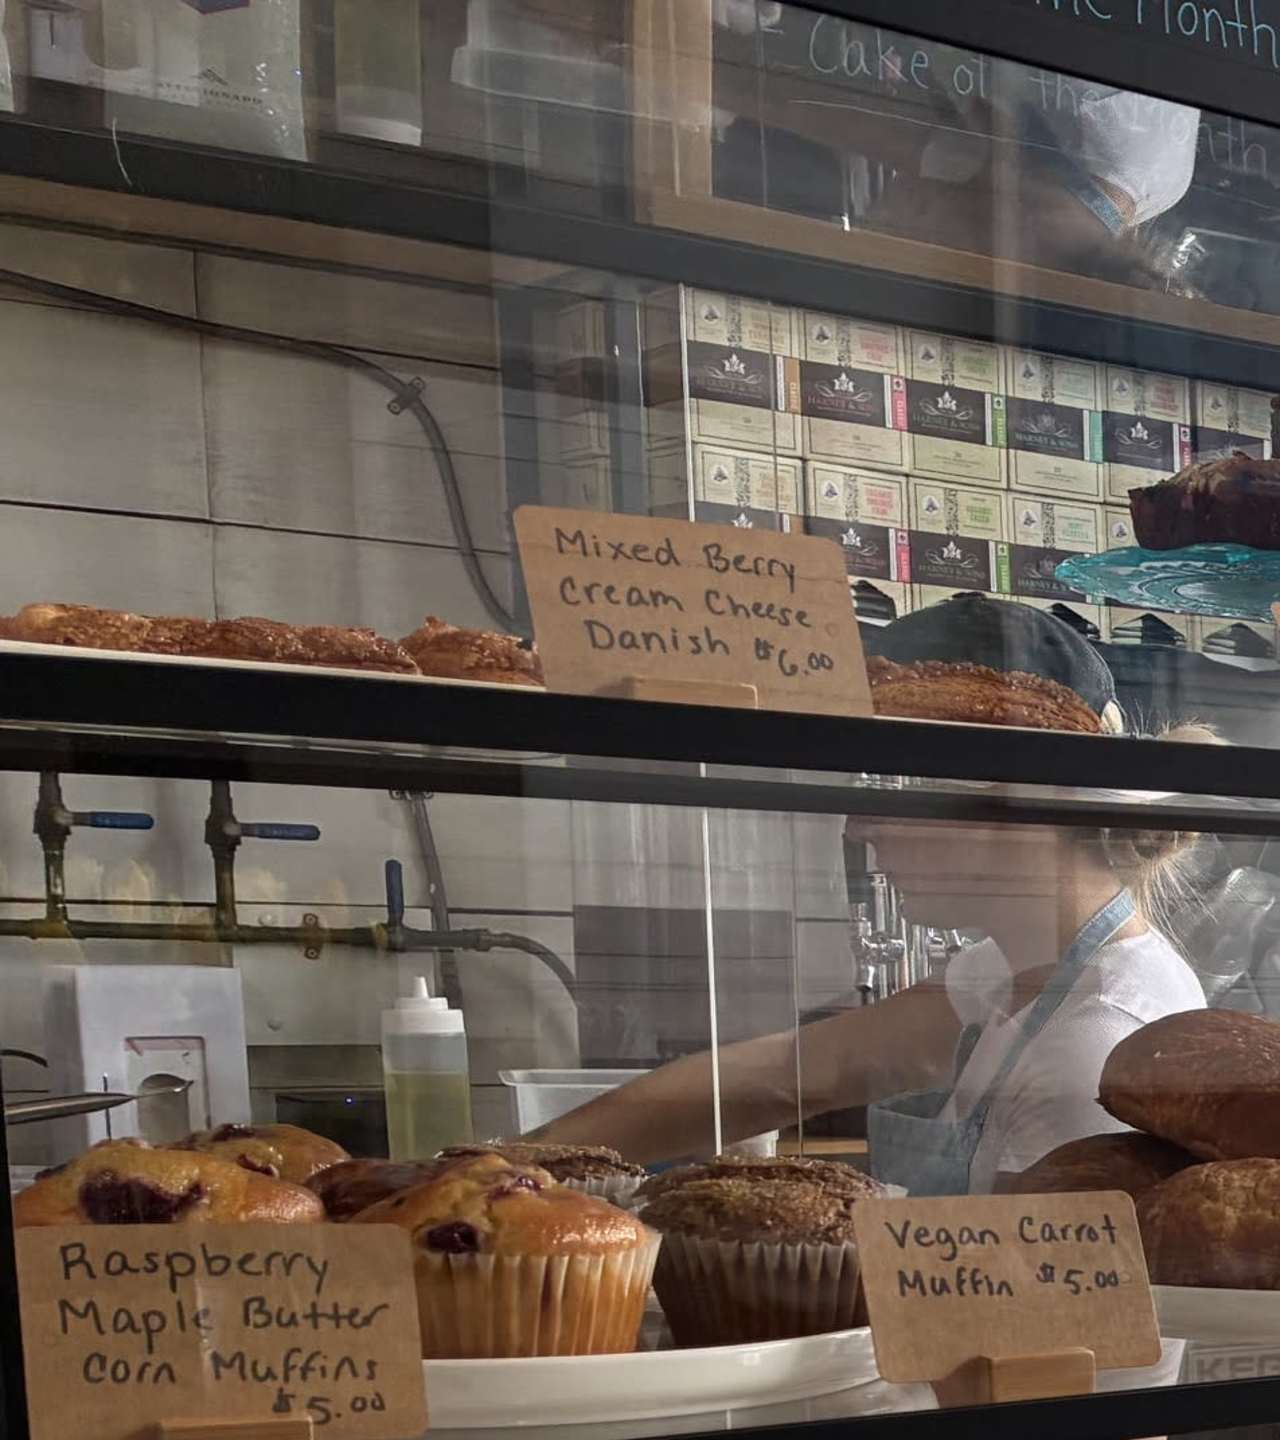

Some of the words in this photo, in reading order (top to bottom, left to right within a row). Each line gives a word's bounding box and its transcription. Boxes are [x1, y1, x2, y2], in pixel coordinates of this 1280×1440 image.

[808, 14, 929, 90] Cake
[554, 526, 681, 567] Mixed
[702, 543, 796, 594] Berry
[558, 575, 686, 613] Cream
[703, 588, 813, 629] Cheese
[583, 619, 731, 656] Danish
[754, 637, 835, 678] $6.00
[884, 1219, 1001, 1262] Vegan
[1017, 1214, 1118, 1245] Carrot
[59, 1241, 330, 1295] Raspberry
[897, 1266, 1015, 1299] Muffin
[1034, 1261, 1121, 1296] $5.00
[58, 1298, 214, 1356] Maple
[241, 1295, 391, 1331] Butter
[82, 1351, 177, 1386] Corn
[209, 1346, 380, 1384] Muffins
[271, 1387, 388, 1426] $5.00
